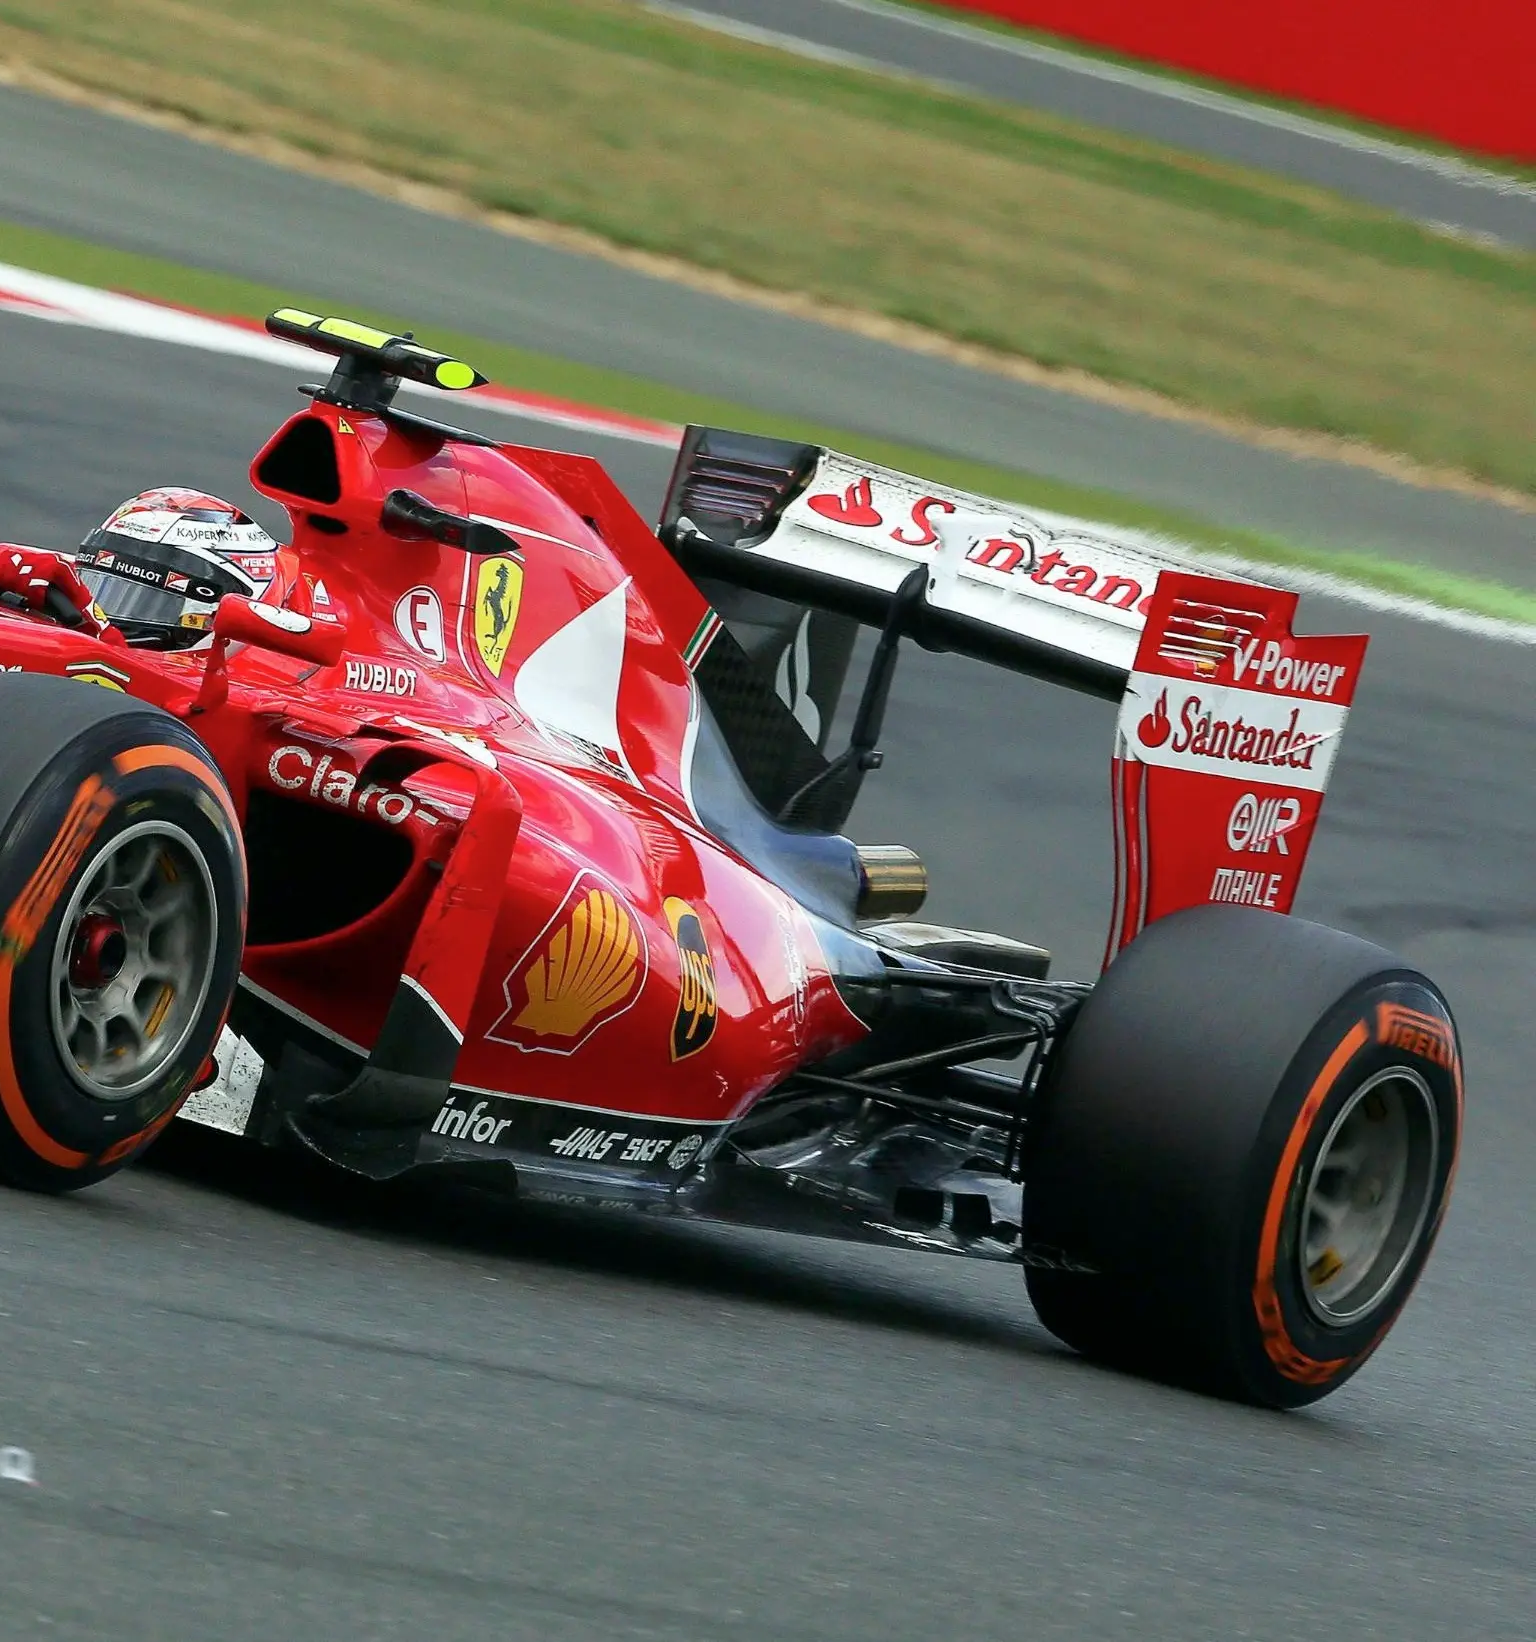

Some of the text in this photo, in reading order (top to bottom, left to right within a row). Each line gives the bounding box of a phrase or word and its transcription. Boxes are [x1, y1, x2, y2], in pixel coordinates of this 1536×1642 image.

[116, 561, 163, 583] HUBLOT
[345, 661, 418, 697] HUBLOT
[1231, 635, 1346, 697] V-Power
[1171, 695, 1321, 771] Santander
[1209, 867, 1282, 908] MAHLE
[680, 946, 716, 1040] ups
[431, 1096, 513, 1145] infor
[549, 1126, 629, 1161] HAAS
[620, 1138, 672, 1162] SKF
